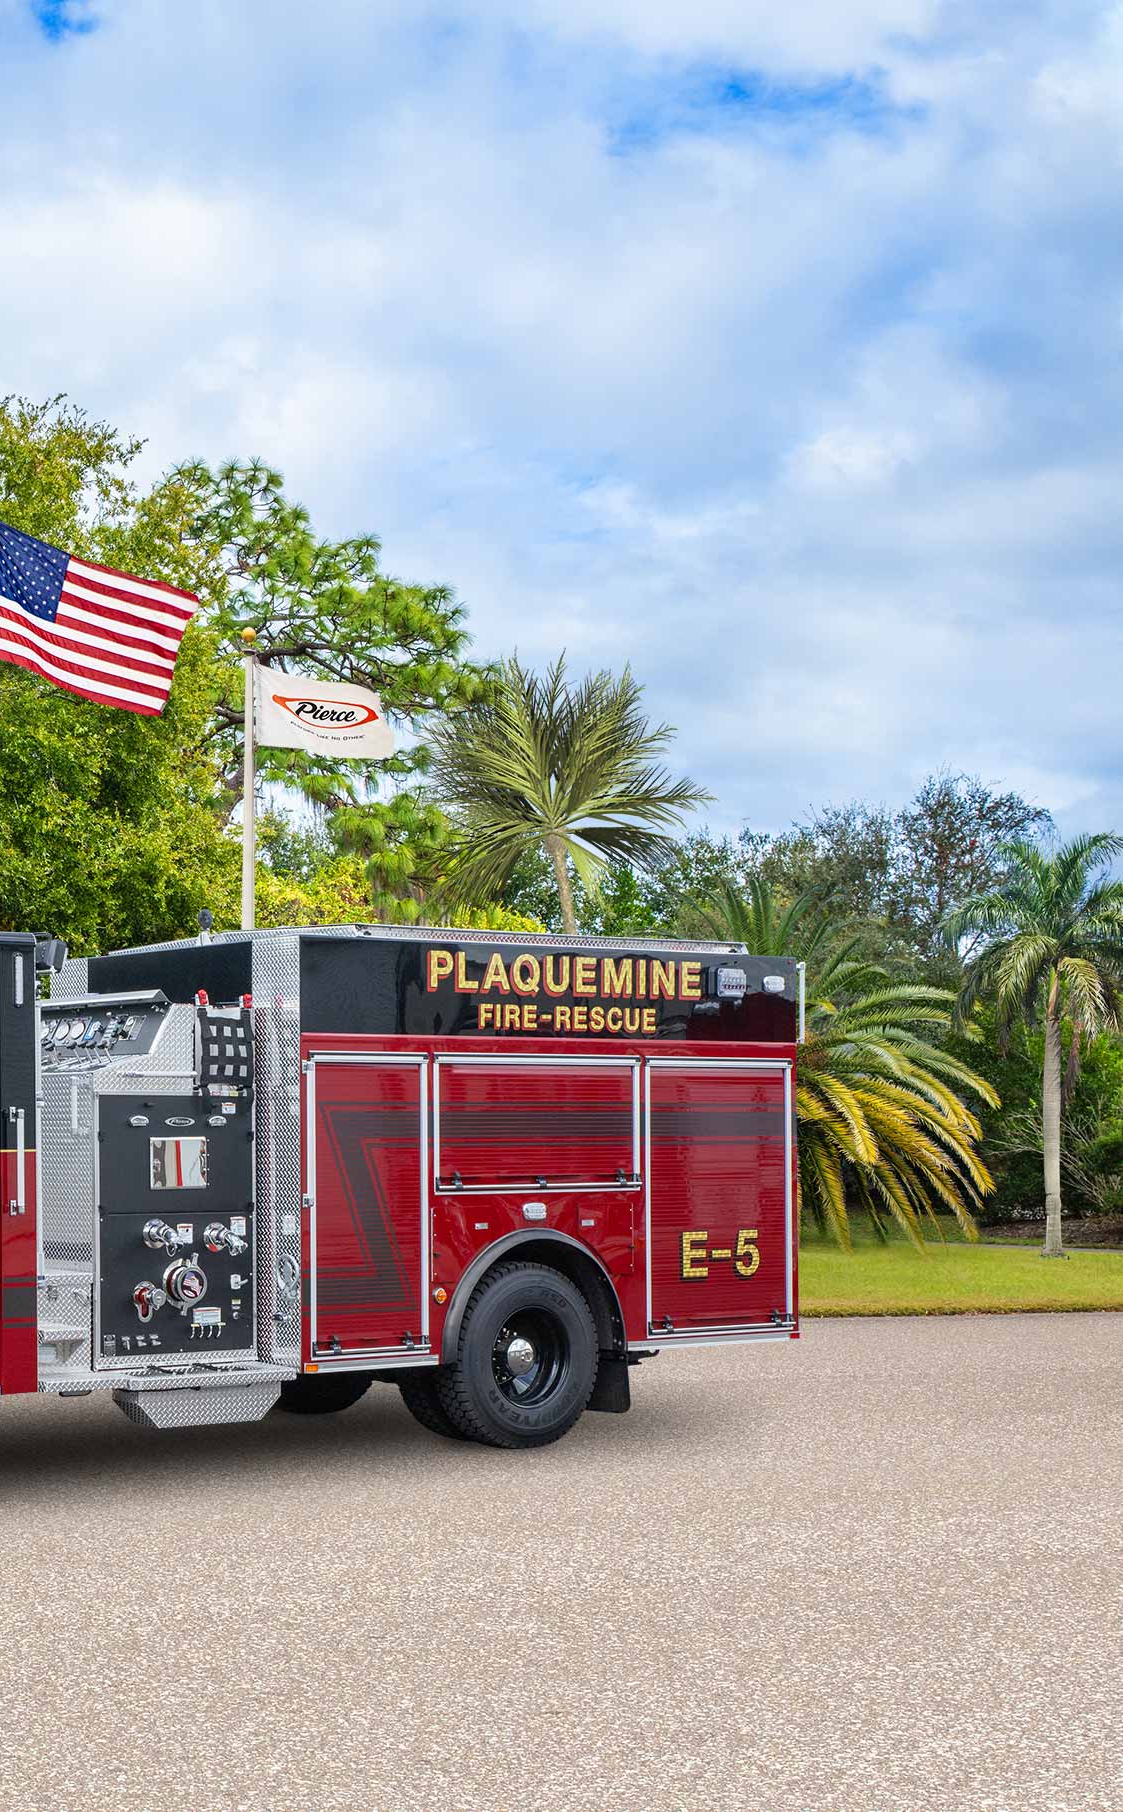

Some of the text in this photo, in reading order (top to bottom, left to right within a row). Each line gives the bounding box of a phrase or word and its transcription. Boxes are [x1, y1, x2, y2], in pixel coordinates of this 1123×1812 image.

[295, 701, 356, 722] Pierce
[427, 950, 703, 1001] PLAQUEMINE
[478, 1003, 657, 1034] FIRE-RESCUE
[681, 1229, 760, 1280] E-5
